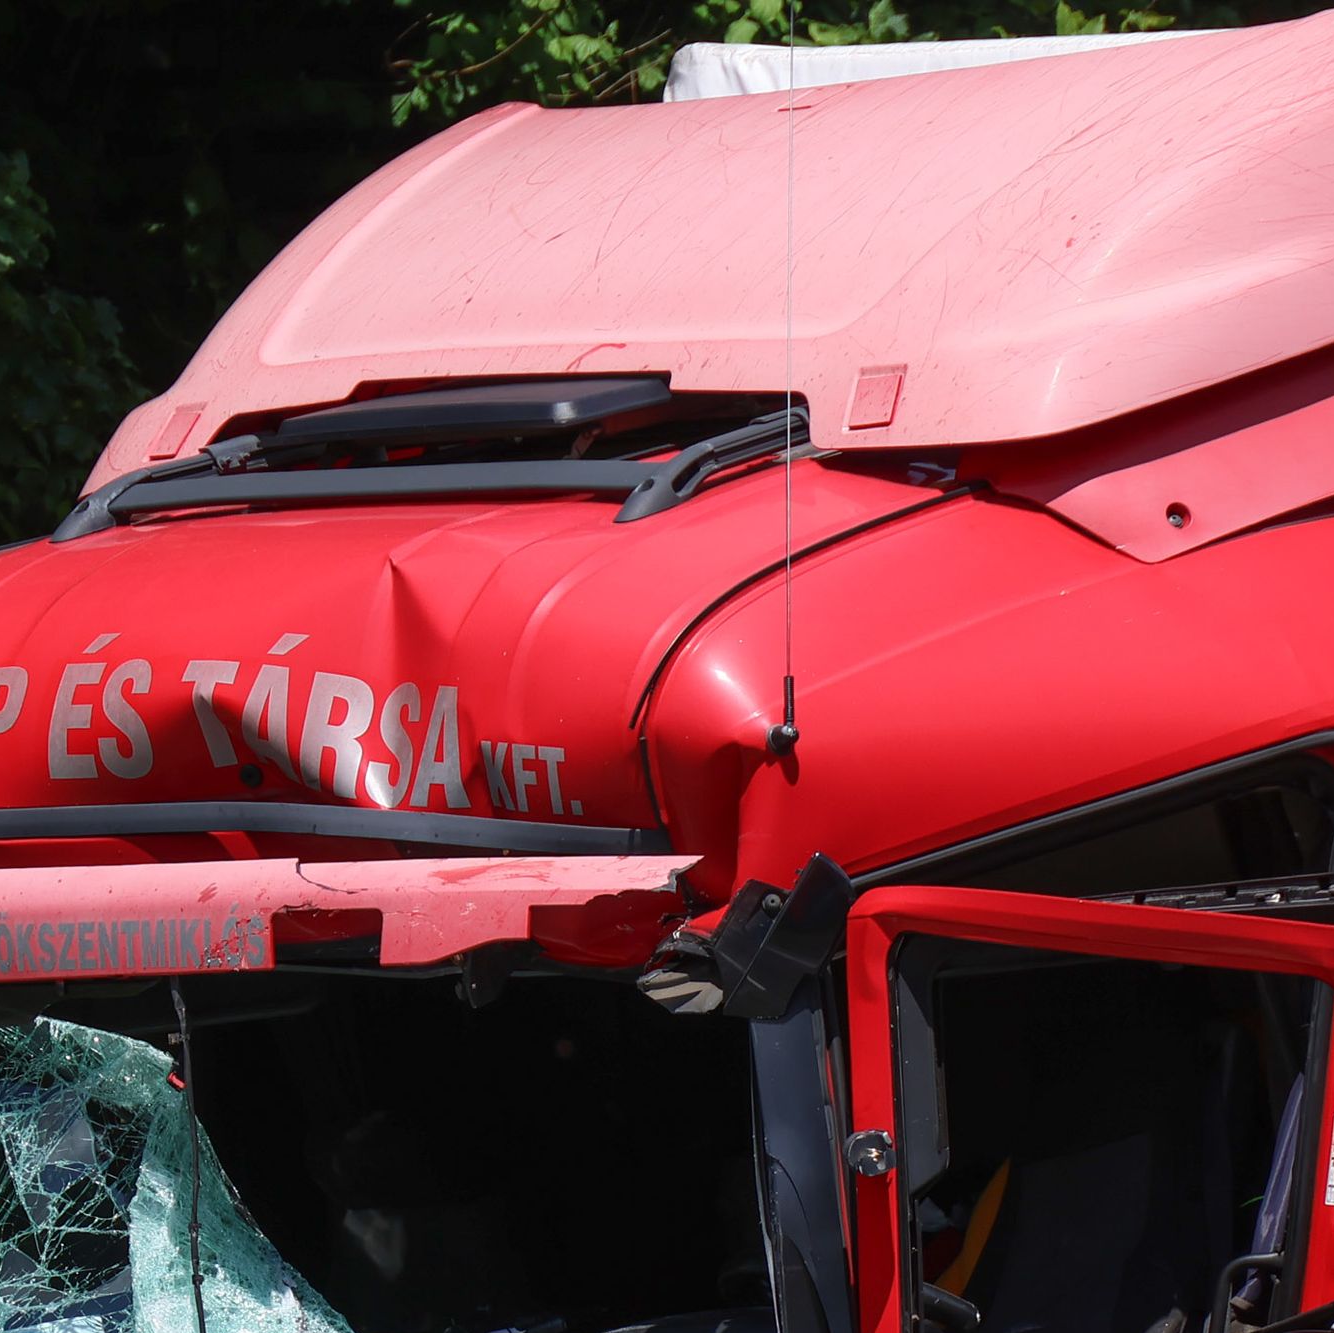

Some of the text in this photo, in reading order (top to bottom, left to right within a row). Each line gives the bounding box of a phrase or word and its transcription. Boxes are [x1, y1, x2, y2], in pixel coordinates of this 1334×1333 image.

[48, 632, 153, 779] ÉS
[181, 633, 472, 809] TÁRSA
[481, 740, 584, 816] KFT.
